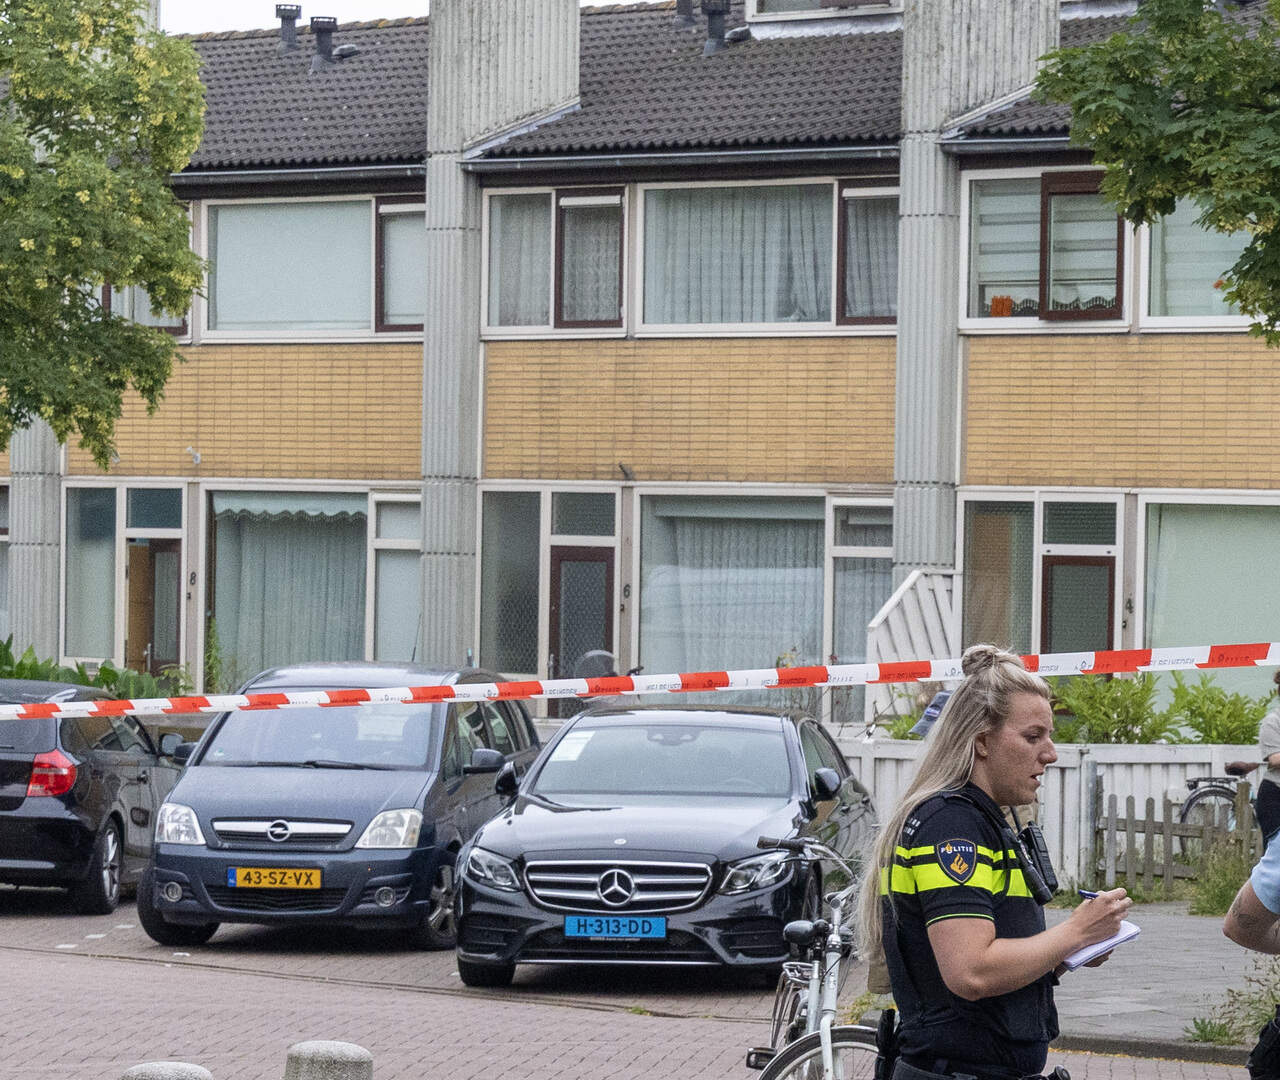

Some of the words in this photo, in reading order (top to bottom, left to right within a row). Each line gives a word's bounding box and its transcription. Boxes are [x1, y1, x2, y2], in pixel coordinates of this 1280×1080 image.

[190, 571, 197, 585] 8
[623, 583, 631, 598] 6
[941, 843, 973, 854] POLITIE
[243, 871, 313, 885] 43-SZ-VX
[577, 919, 652, 934] H-313-DD
